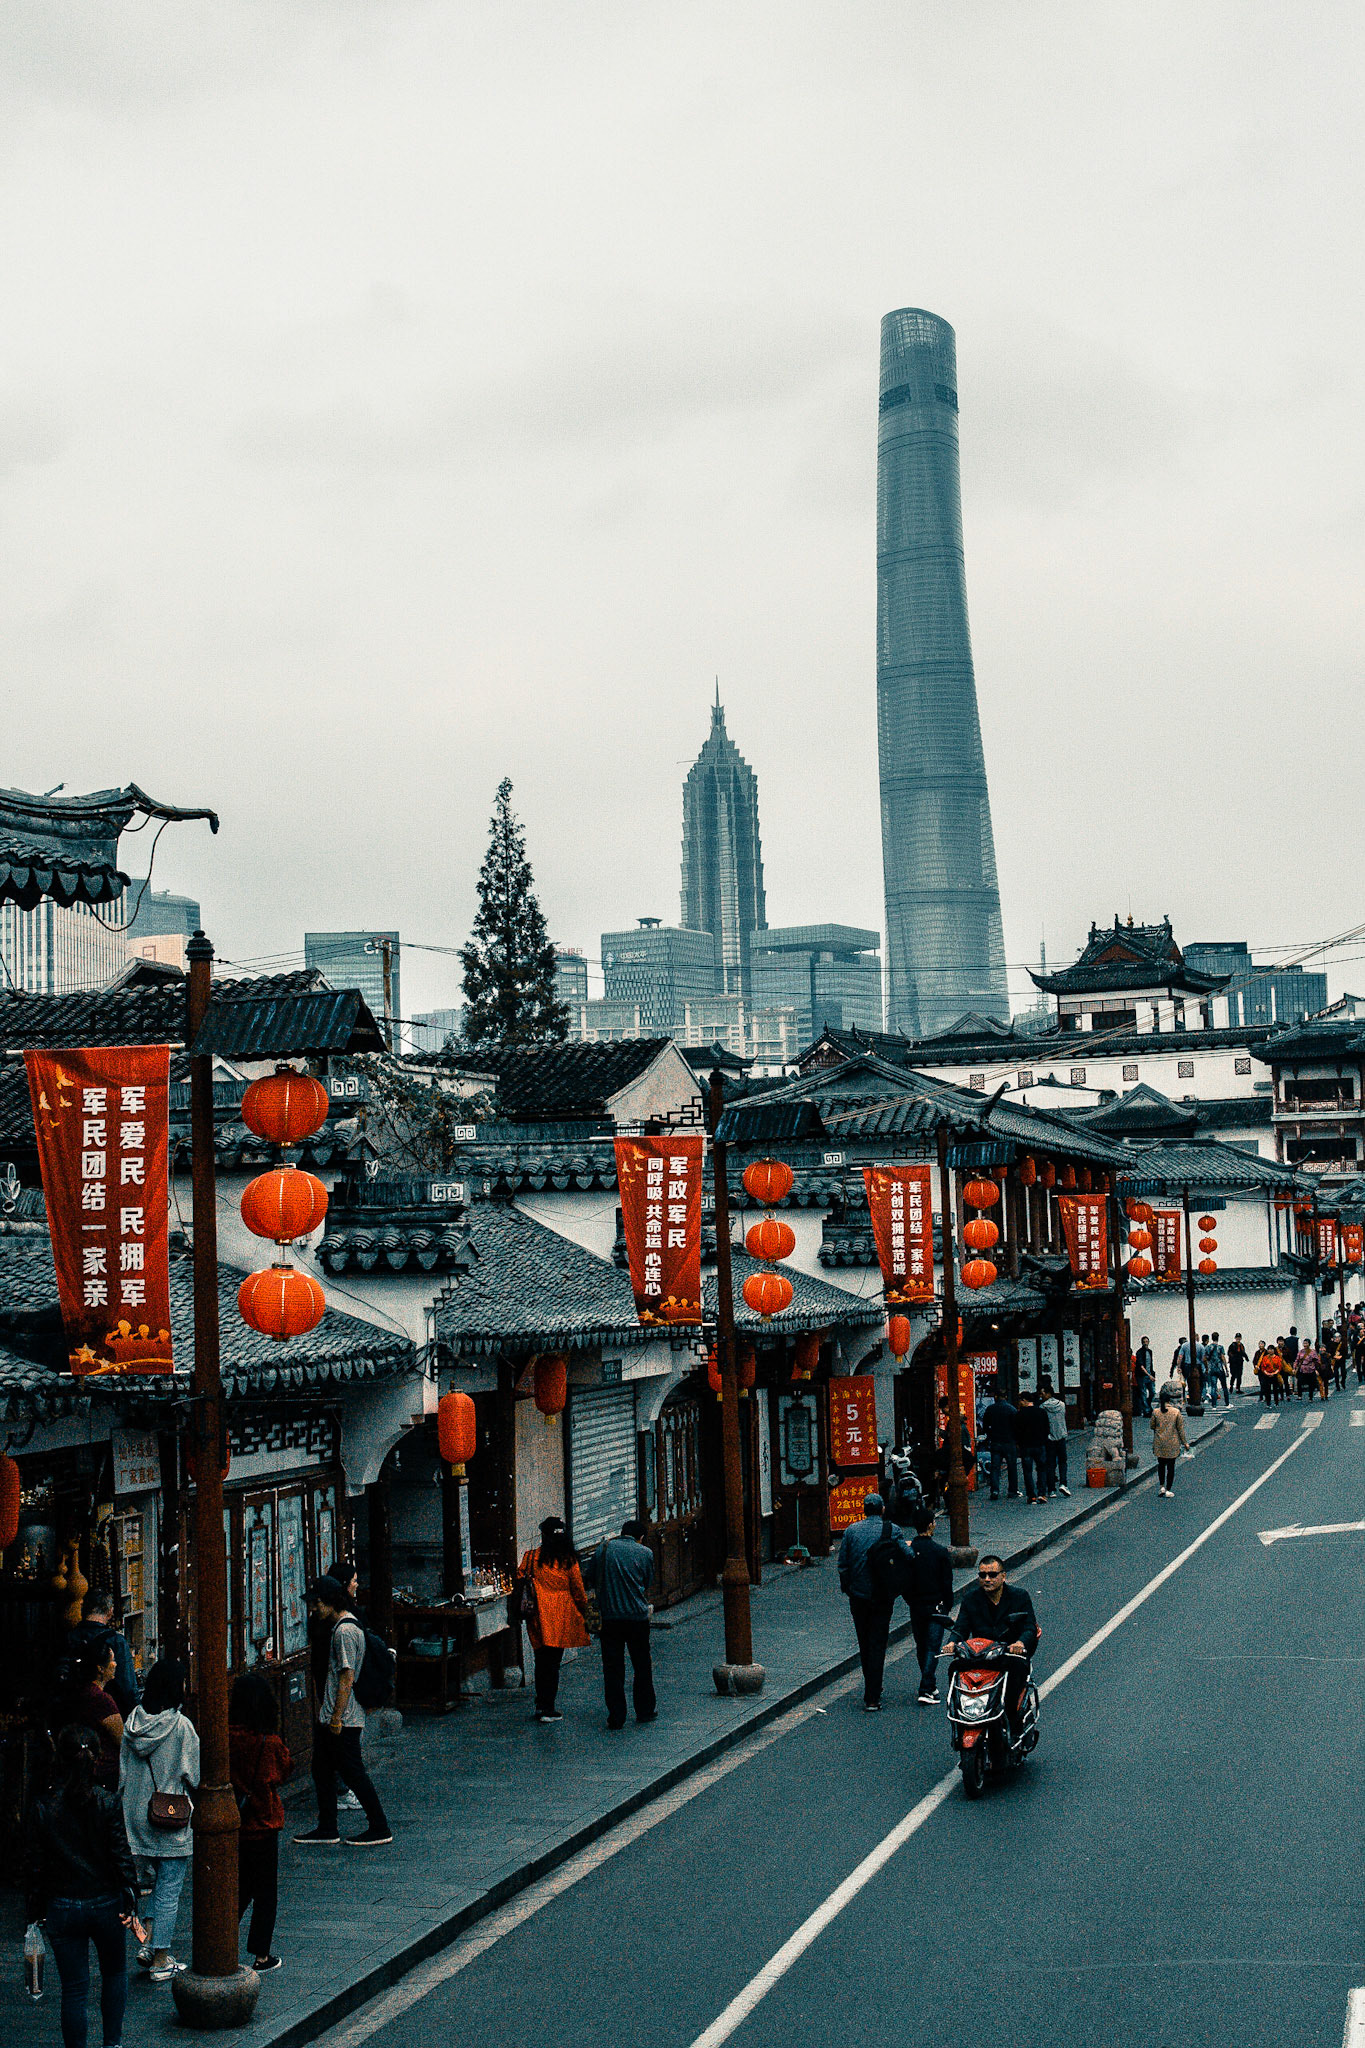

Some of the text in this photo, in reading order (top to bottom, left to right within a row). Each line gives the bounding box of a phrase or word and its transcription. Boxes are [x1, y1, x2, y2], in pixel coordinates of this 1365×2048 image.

[81, 1087, 108, 1308] 军民团结一家亲
[119, 1086, 146, 1308] 军爱民民拥军
[644, 1157, 664, 1296] 同呼吸共命运心连心
[667, 1156, 689, 1249] 军政军民
[890, 1181, 907, 1276] 共创双拥模范城
[908, 1180, 925, 1275] 军民团结一家亲
[1077, 1206, 1089, 1271] 军民团结一家亲
